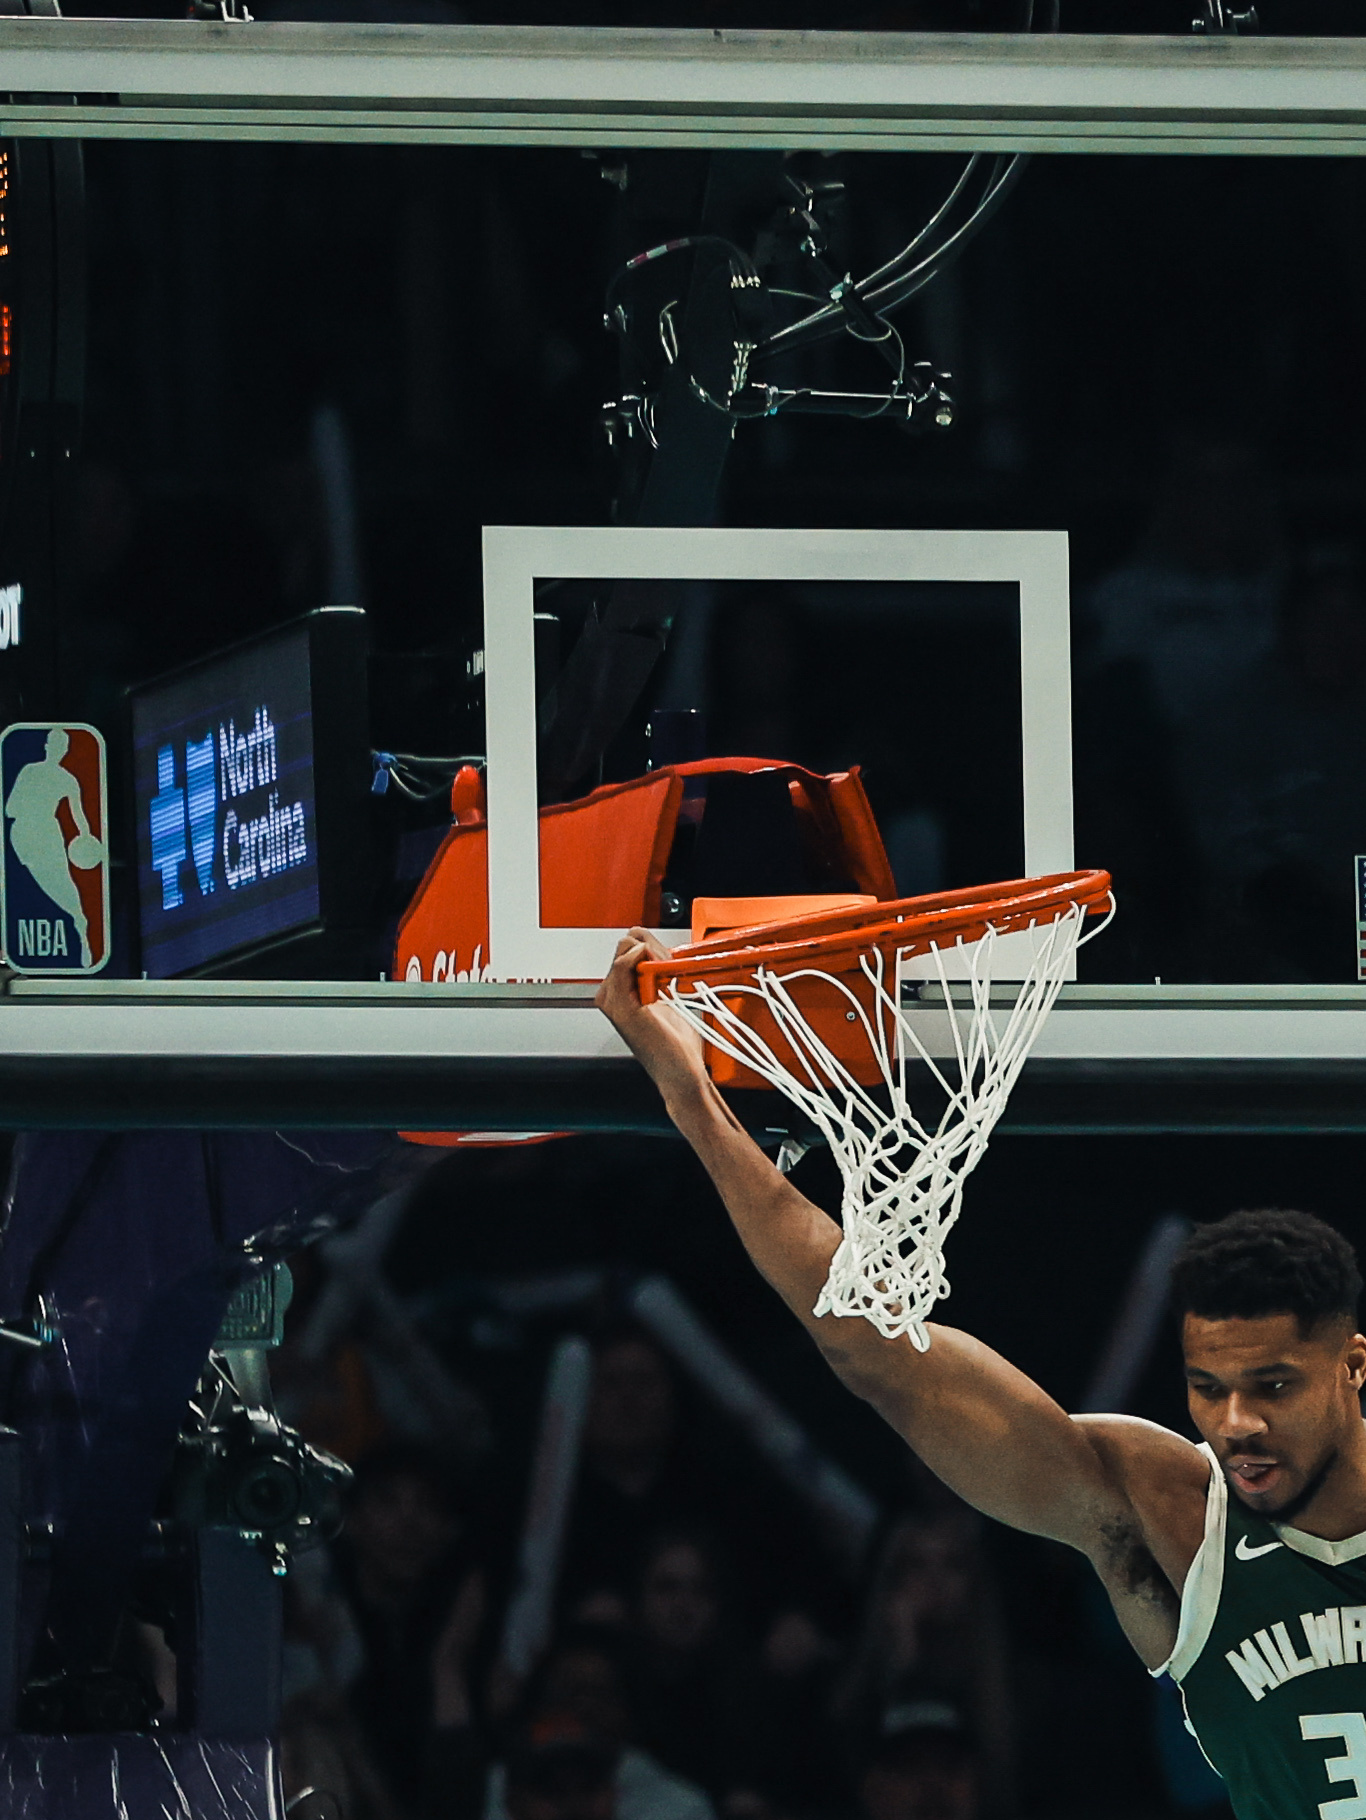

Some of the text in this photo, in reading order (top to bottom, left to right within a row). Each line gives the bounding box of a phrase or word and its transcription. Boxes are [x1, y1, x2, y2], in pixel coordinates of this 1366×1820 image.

[219, 704, 276, 801] North
[223, 788, 307, 890] Carolina
[18, 919, 68, 957] NBA
